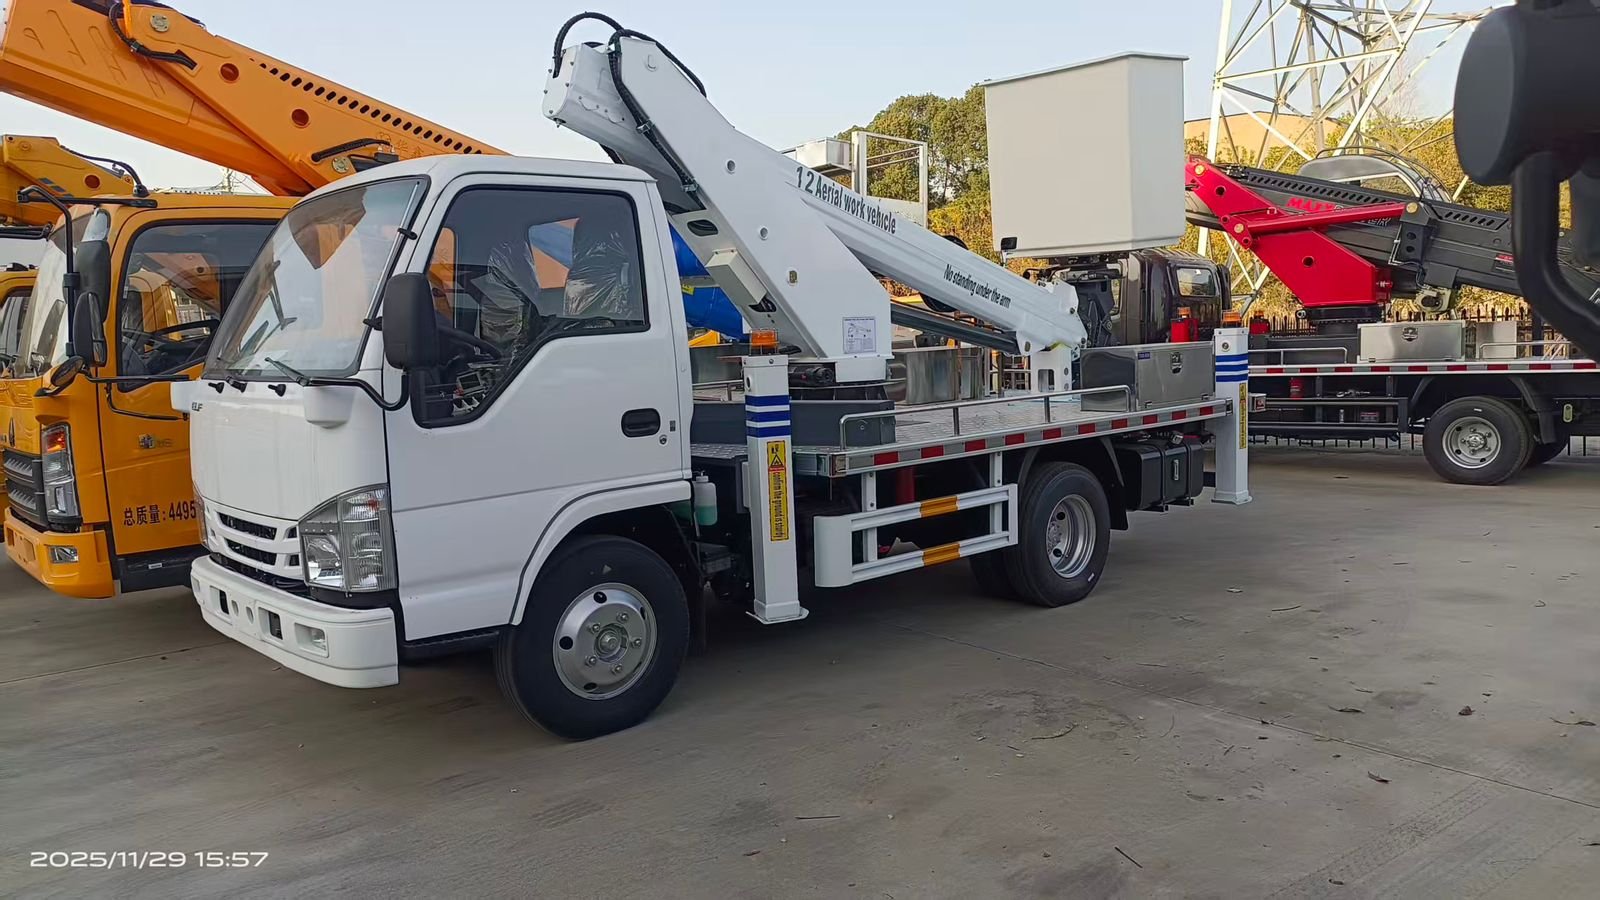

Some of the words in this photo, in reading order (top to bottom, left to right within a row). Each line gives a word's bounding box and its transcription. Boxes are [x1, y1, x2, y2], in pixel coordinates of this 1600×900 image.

[815, 175, 843, 208] Aerial
[844, 193, 865, 220] work
[866, 204, 896, 234] vehicle
[943, 263, 954, 282] No
[952, 270, 977, 296] standing
[976, 282, 992, 300] under
[990, 287, 1001, 304] the
